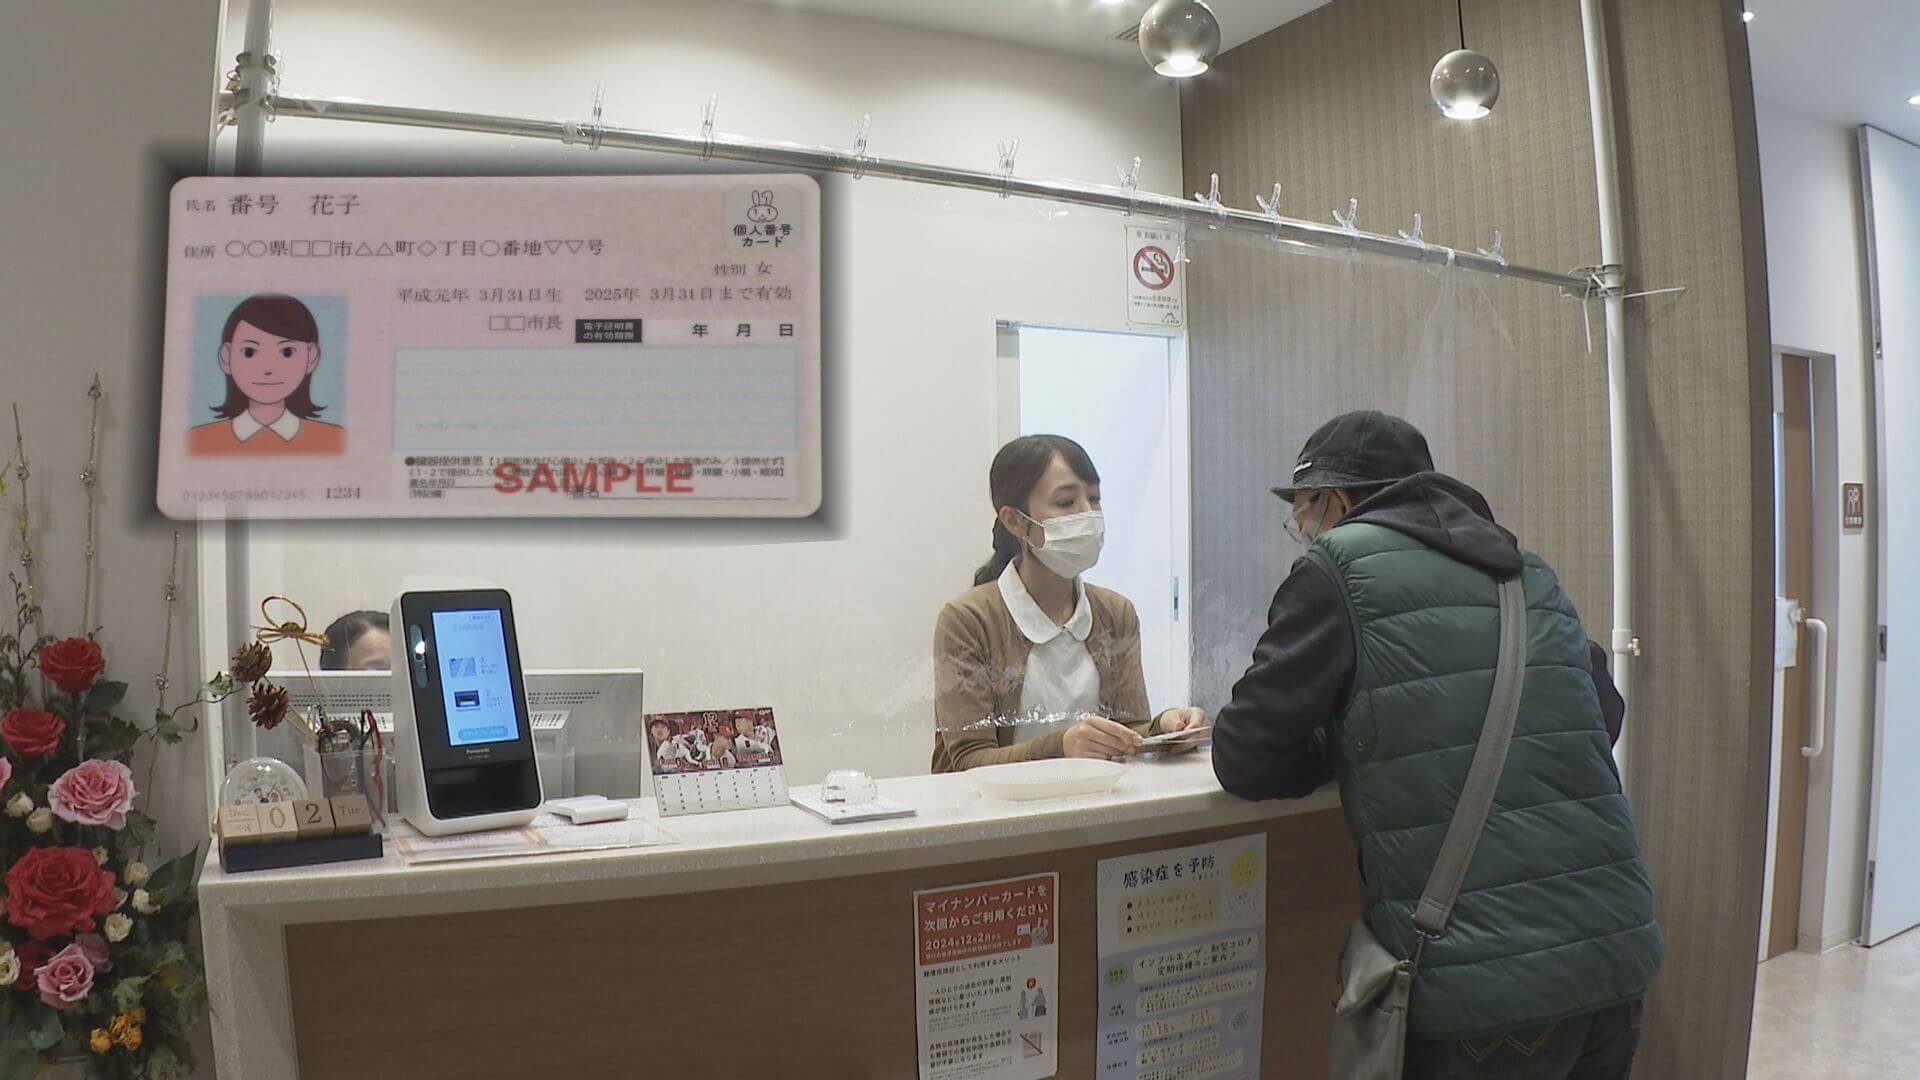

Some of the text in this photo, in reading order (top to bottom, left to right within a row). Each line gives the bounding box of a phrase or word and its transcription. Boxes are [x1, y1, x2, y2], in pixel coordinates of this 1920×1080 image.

[269, 807, 286, 829] 0
[304, 802, 322, 824] 2
[1122, 854, 1216, 889] 感染症を予防
[926, 884, 1048, 914] マイナンバーカードを
[924, 902, 1049, 933] 次回からご利用ください
